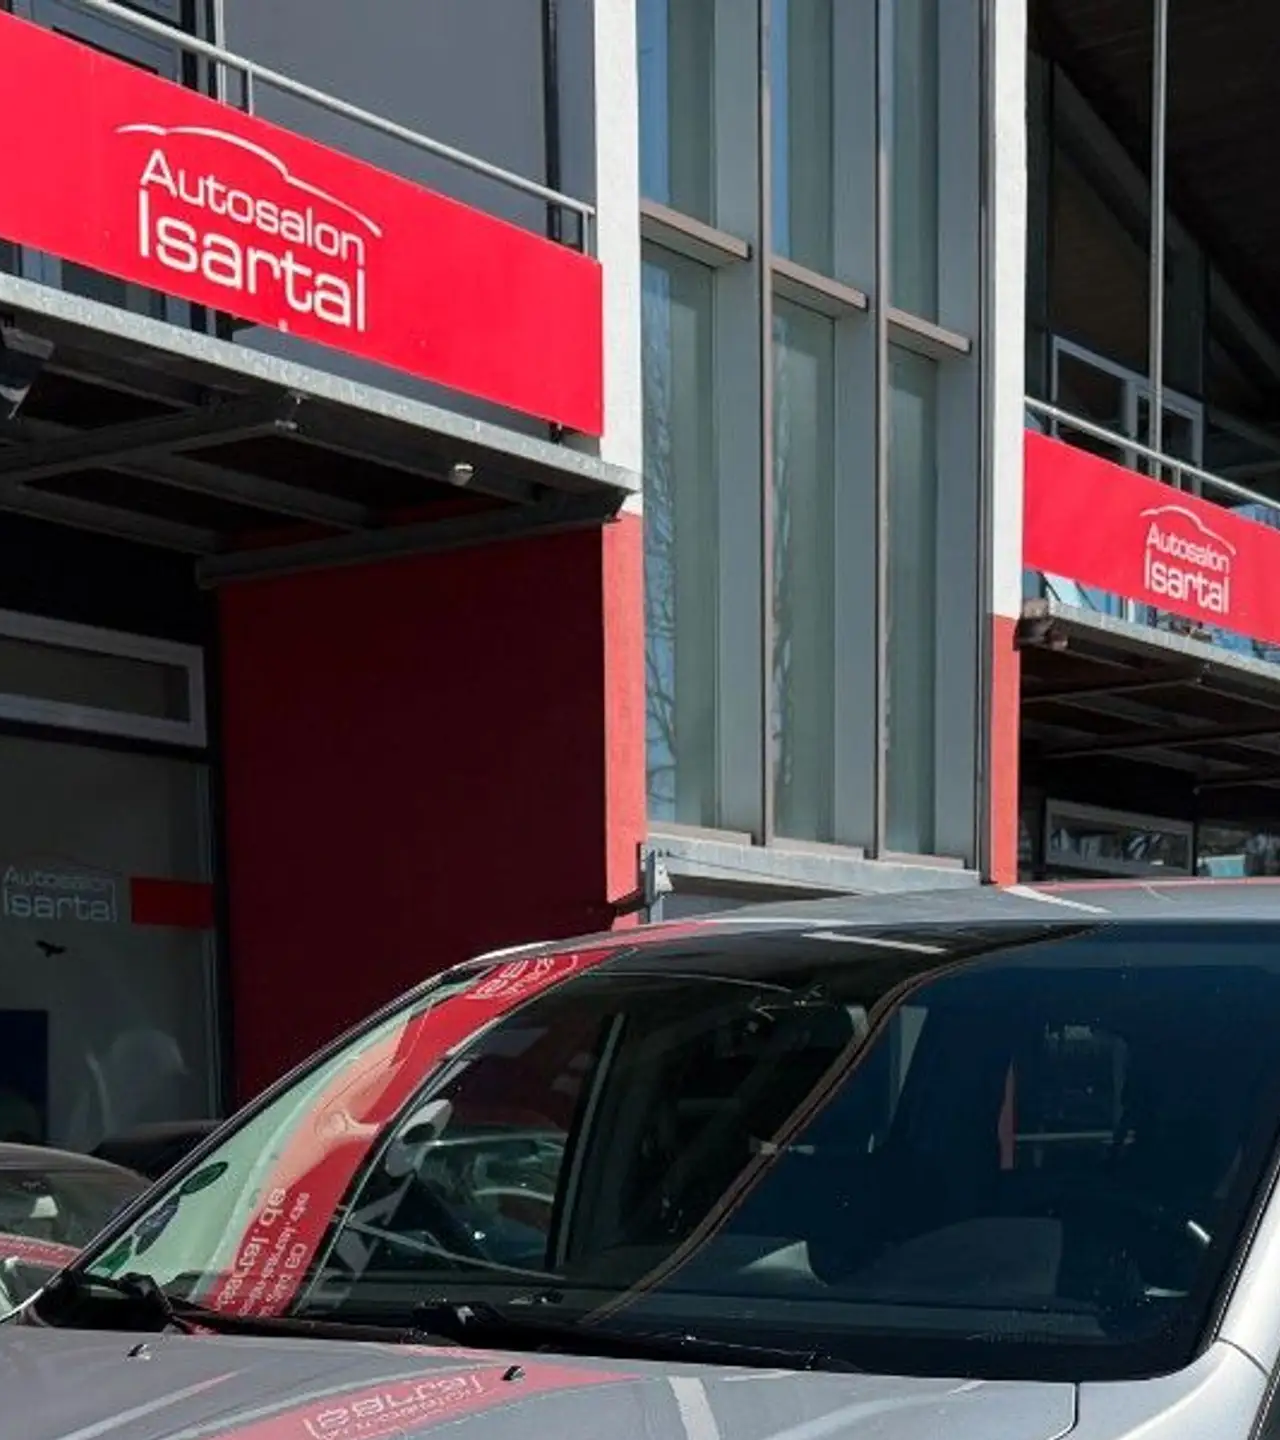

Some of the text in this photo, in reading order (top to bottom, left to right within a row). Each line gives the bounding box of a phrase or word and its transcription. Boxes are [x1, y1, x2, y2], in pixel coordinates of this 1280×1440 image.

[140, 149, 365, 266] Autosalon
[138, 188, 367, 332] Isartal
[1144, 548, 1231, 615] Isartal
[1146, 521, 1231, 575] Autosalon
